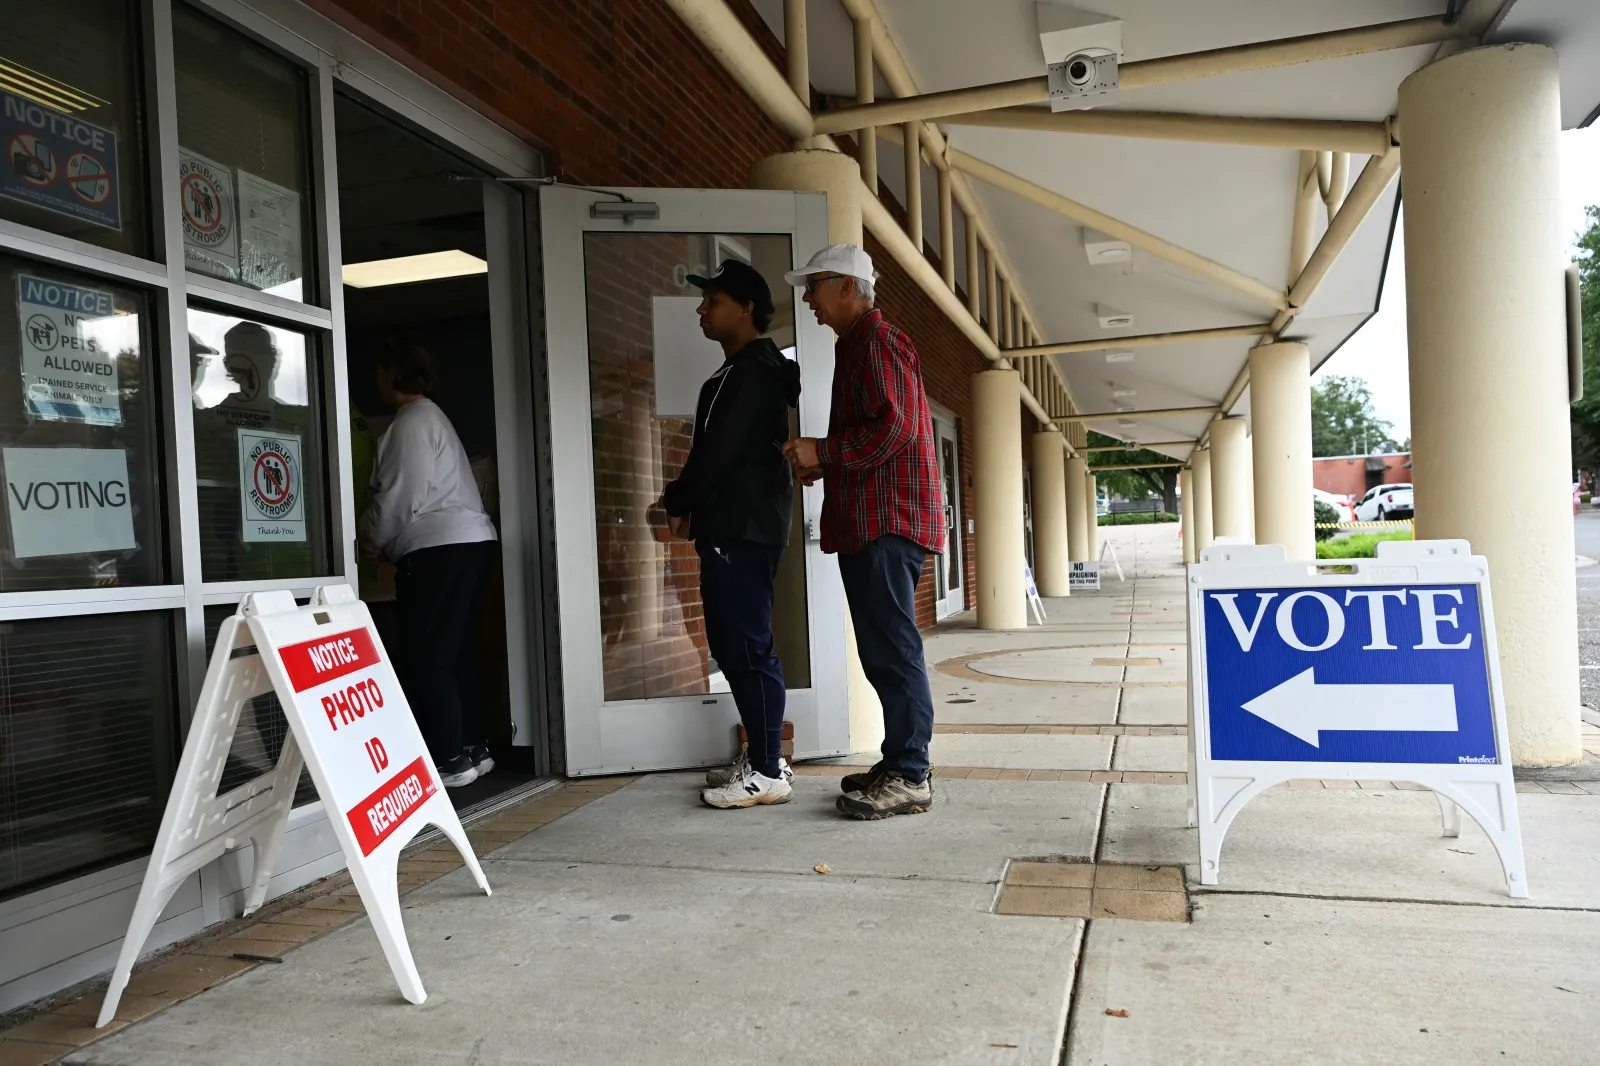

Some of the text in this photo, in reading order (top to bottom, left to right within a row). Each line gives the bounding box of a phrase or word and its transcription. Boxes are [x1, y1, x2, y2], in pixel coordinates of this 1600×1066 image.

[4, 95, 105, 152] NOTICE
[190, 161, 223, 194] PUBLIC
[182, 212, 226, 243] ESTROOMS
[26, 281, 109, 314] NOTICE
[61, 335, 96, 353] PETS
[43, 355, 113, 376] ALLOWED
[37, 377, 108, 393] TRAINED SERVICE
[82, 395, 103, 404] ONLY
[250, 440, 292, 465] NO PUBLIC
[9, 479, 127, 511] VOTING
[250, 488, 295, 516] RESTROOMS
[257, 526, 296, 536] Thank You
[1073, 562, 1084, 571] NO
[1209, 587, 1473, 653] VOTE
[307, 636, 359, 674] NOTICE
[320, 677, 384, 732] PHOTO
[364, 736, 389, 774] ID
[366, 773, 423, 837] REQUIRED
